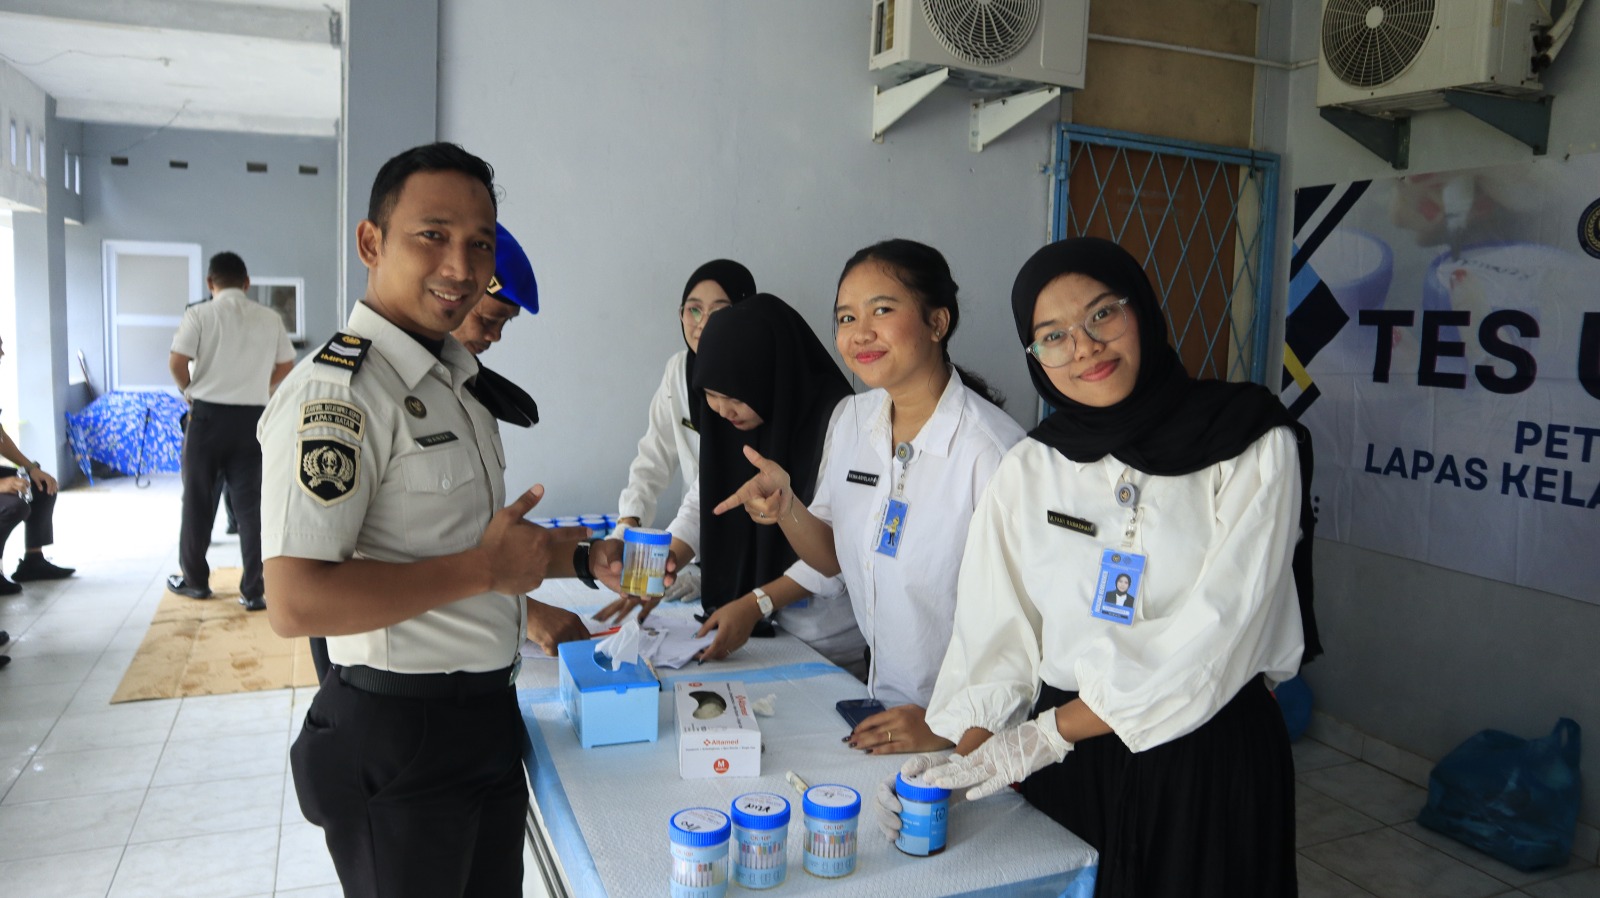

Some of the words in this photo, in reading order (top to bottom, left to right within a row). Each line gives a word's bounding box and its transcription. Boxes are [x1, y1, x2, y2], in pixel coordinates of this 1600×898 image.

[1358, 309, 1540, 394] TES
[309, 414, 332, 423] LAPAS
[1514, 420, 1600, 463] PET
[1364, 443, 1488, 491] LAPAS
